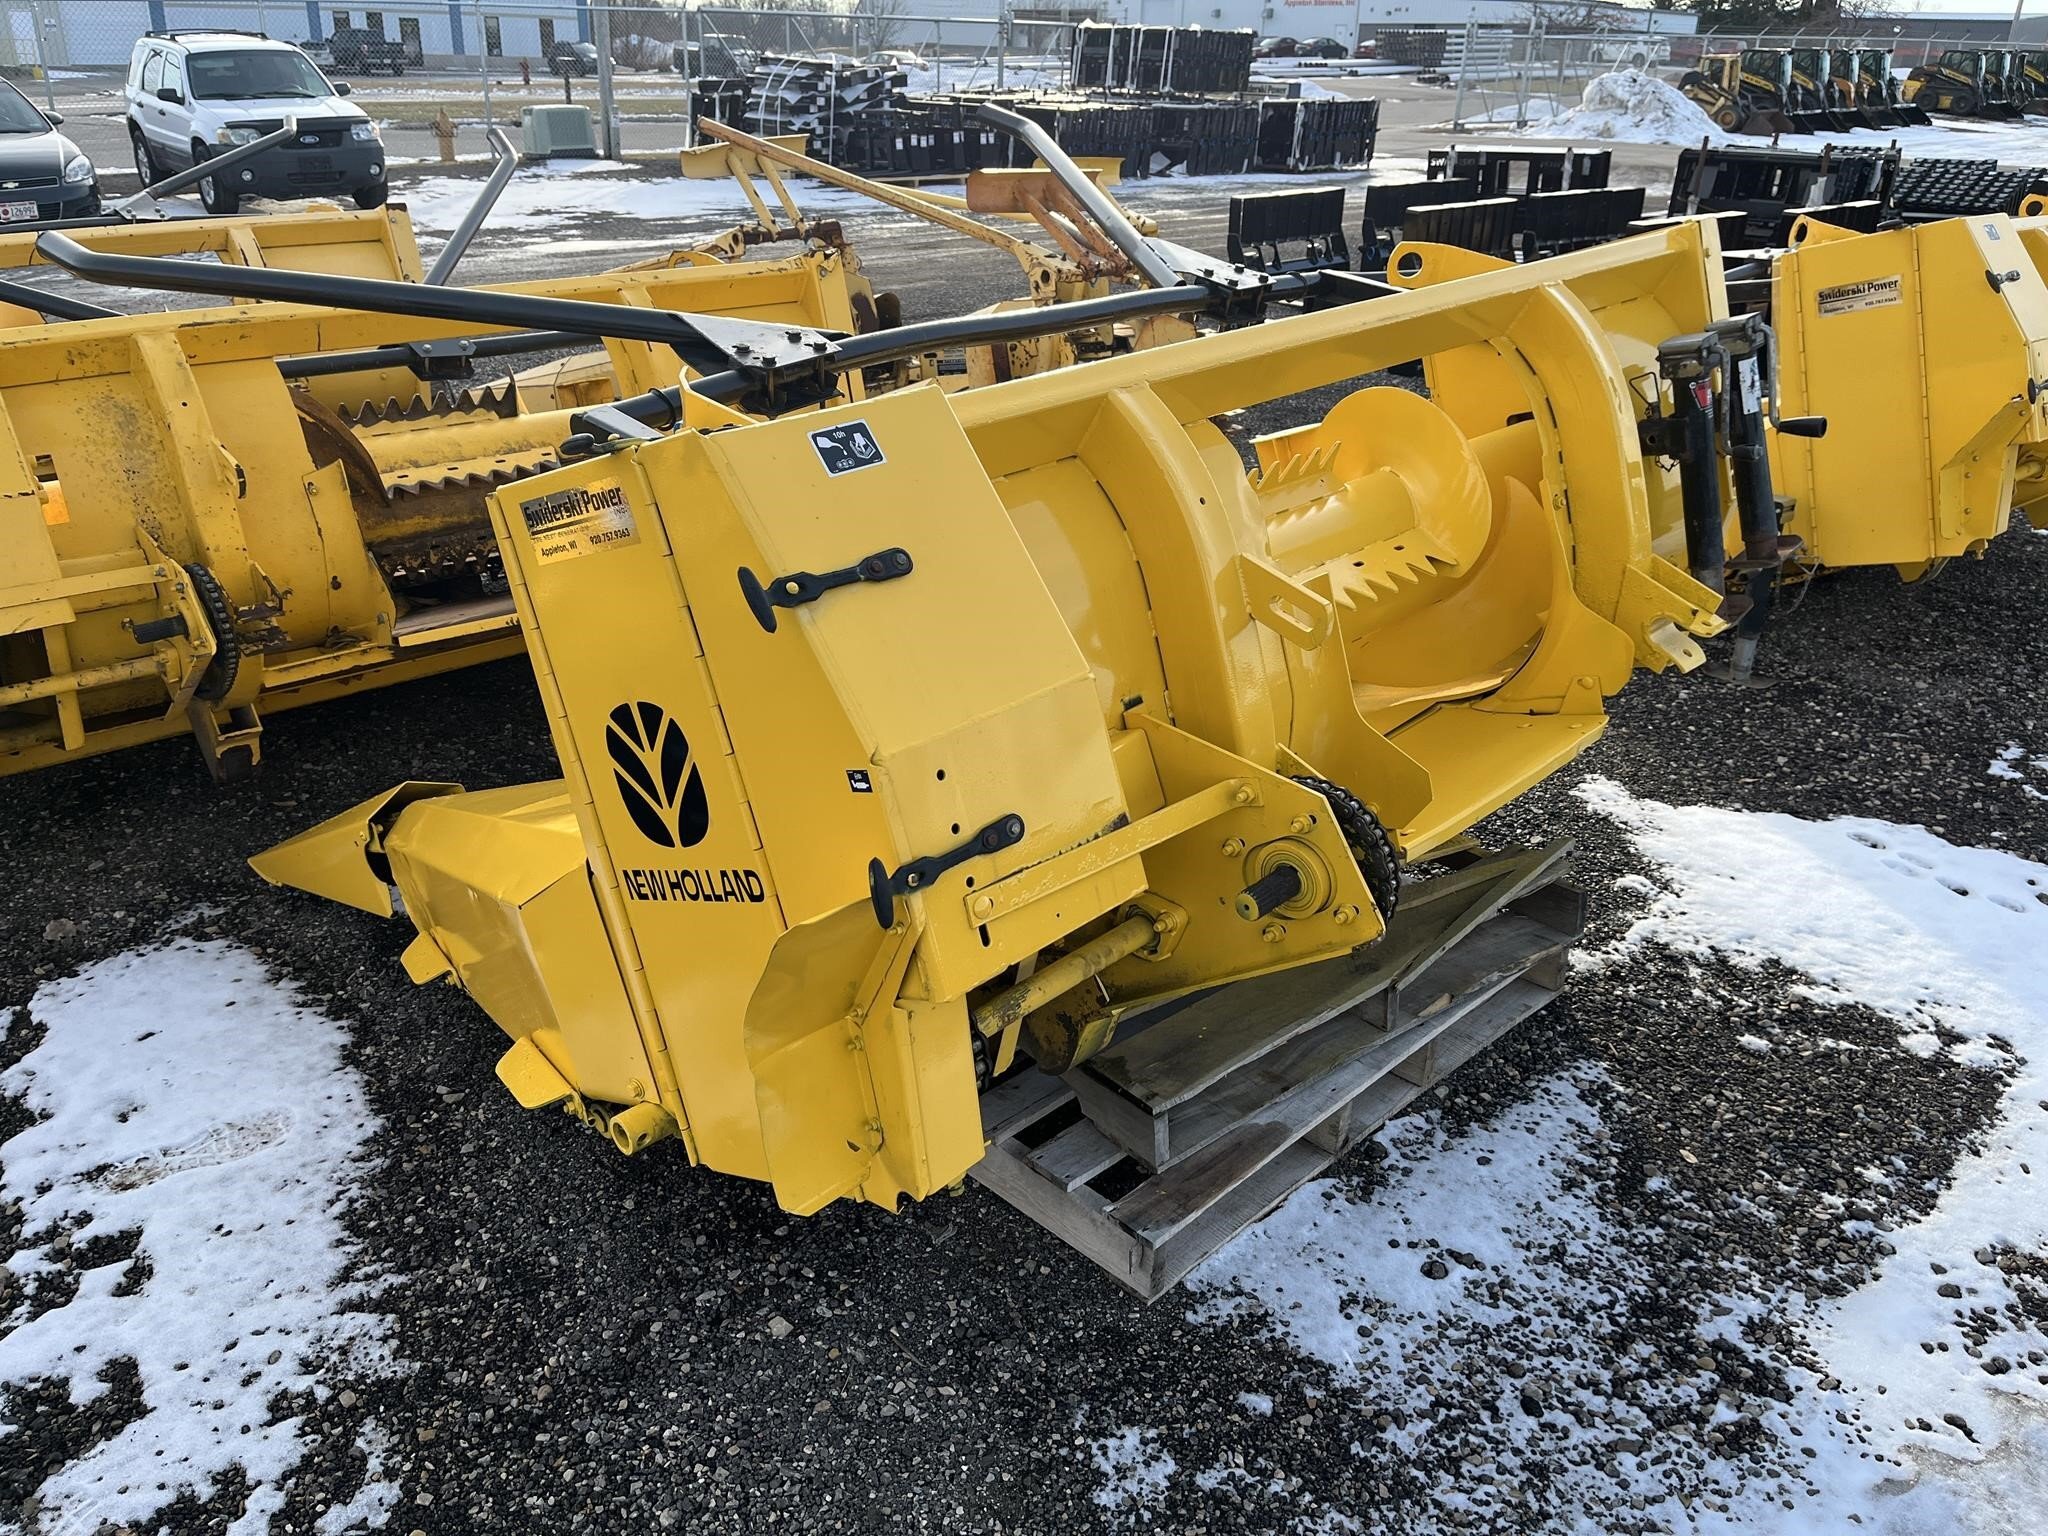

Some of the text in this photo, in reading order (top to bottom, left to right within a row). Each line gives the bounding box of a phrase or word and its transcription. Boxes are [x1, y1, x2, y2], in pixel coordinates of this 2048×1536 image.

[1818, 280, 1899, 301] Swiderski Power
[833, 431, 846, 439] 10h
[523, 487, 622, 528] Swiderski Power
[589, 528, 631, 545] 920.757.9363
[541, 540, 578, 557] Appleton, WI
[622, 869, 765, 903] NEW HOLLAND
